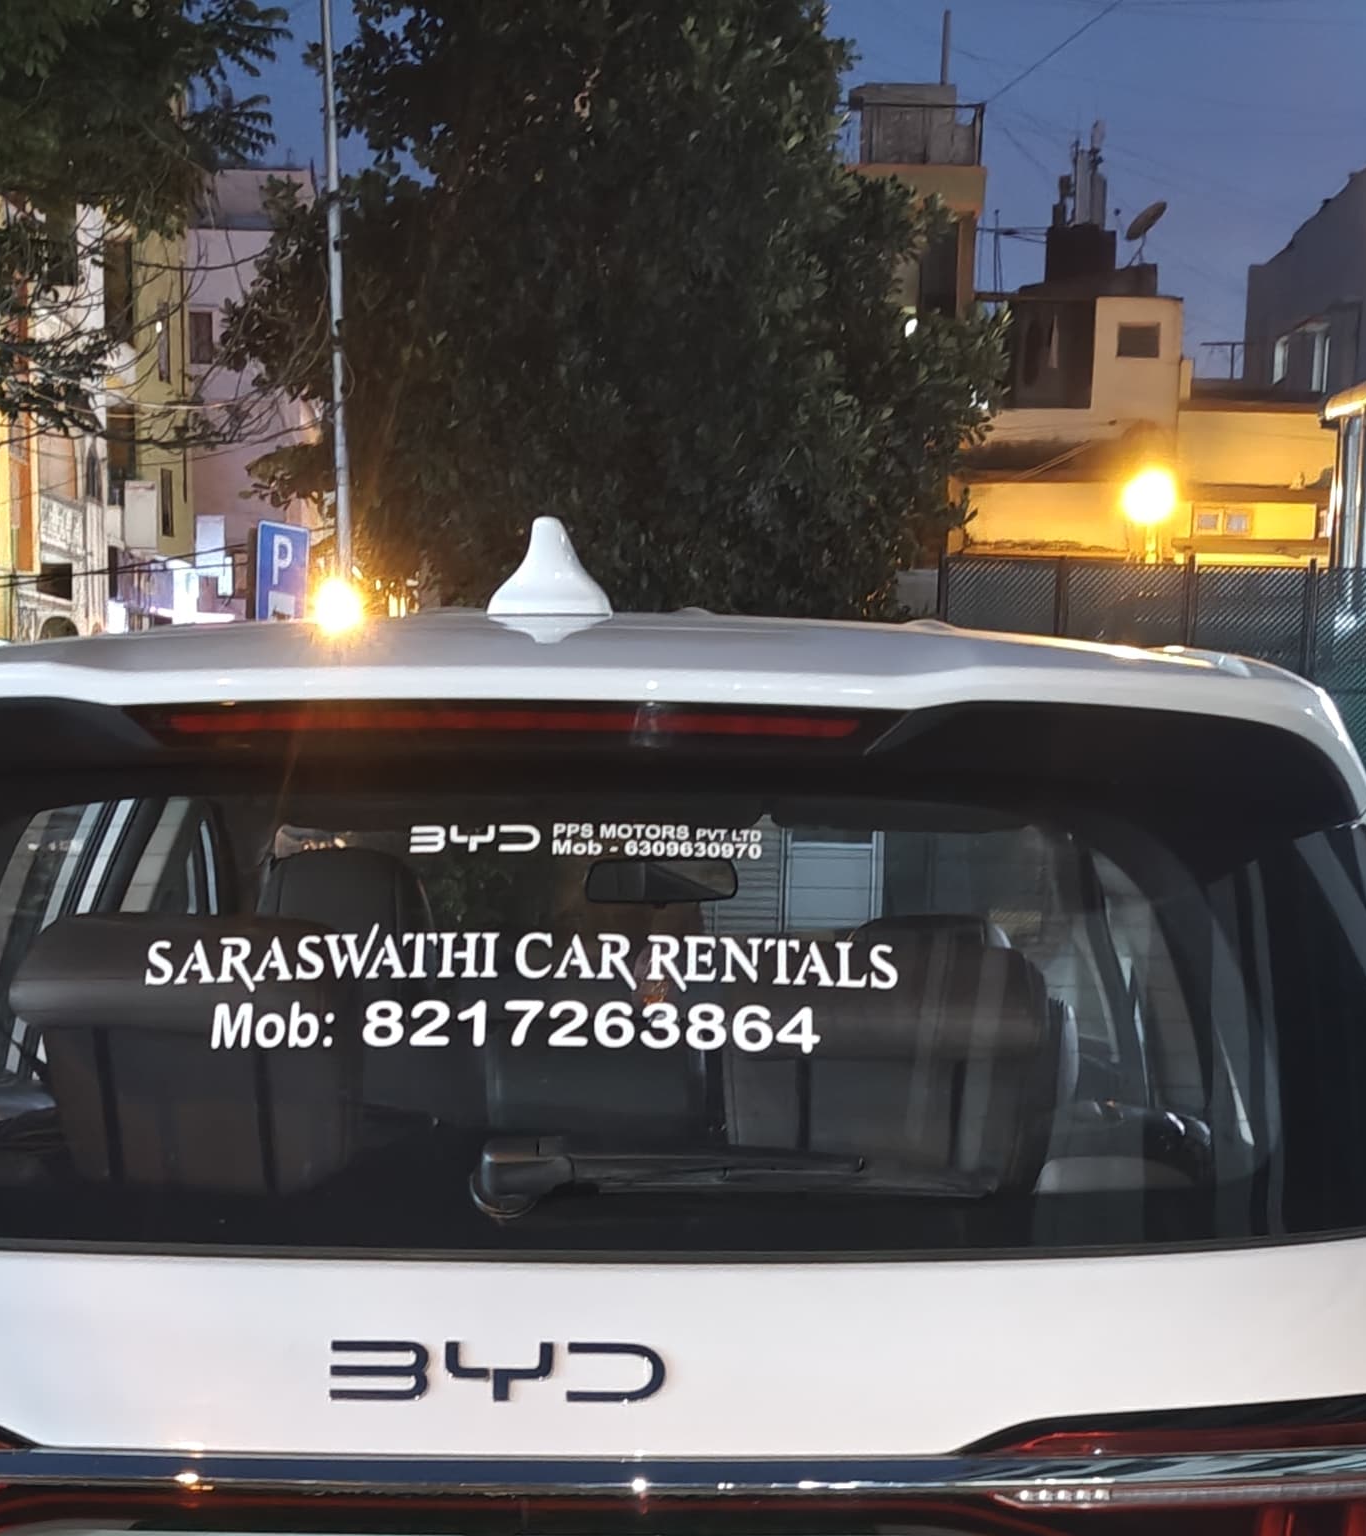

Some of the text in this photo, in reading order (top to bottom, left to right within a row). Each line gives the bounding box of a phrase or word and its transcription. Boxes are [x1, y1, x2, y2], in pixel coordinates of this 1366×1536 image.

[272, 534, 293, 584] P
[409, 824, 541, 853] BYD
[551, 839, 602, 856] Mob
[624, 839, 762, 860] 6309630970
[552, 823, 762, 843] PPS MOTORS PVT LTD
[145, 922, 899, 993] SARASWATHI CAR RENTALS
[210, 999, 822, 1054] Mob: 8217263864
[329, 1339, 666, 1402] BYD
